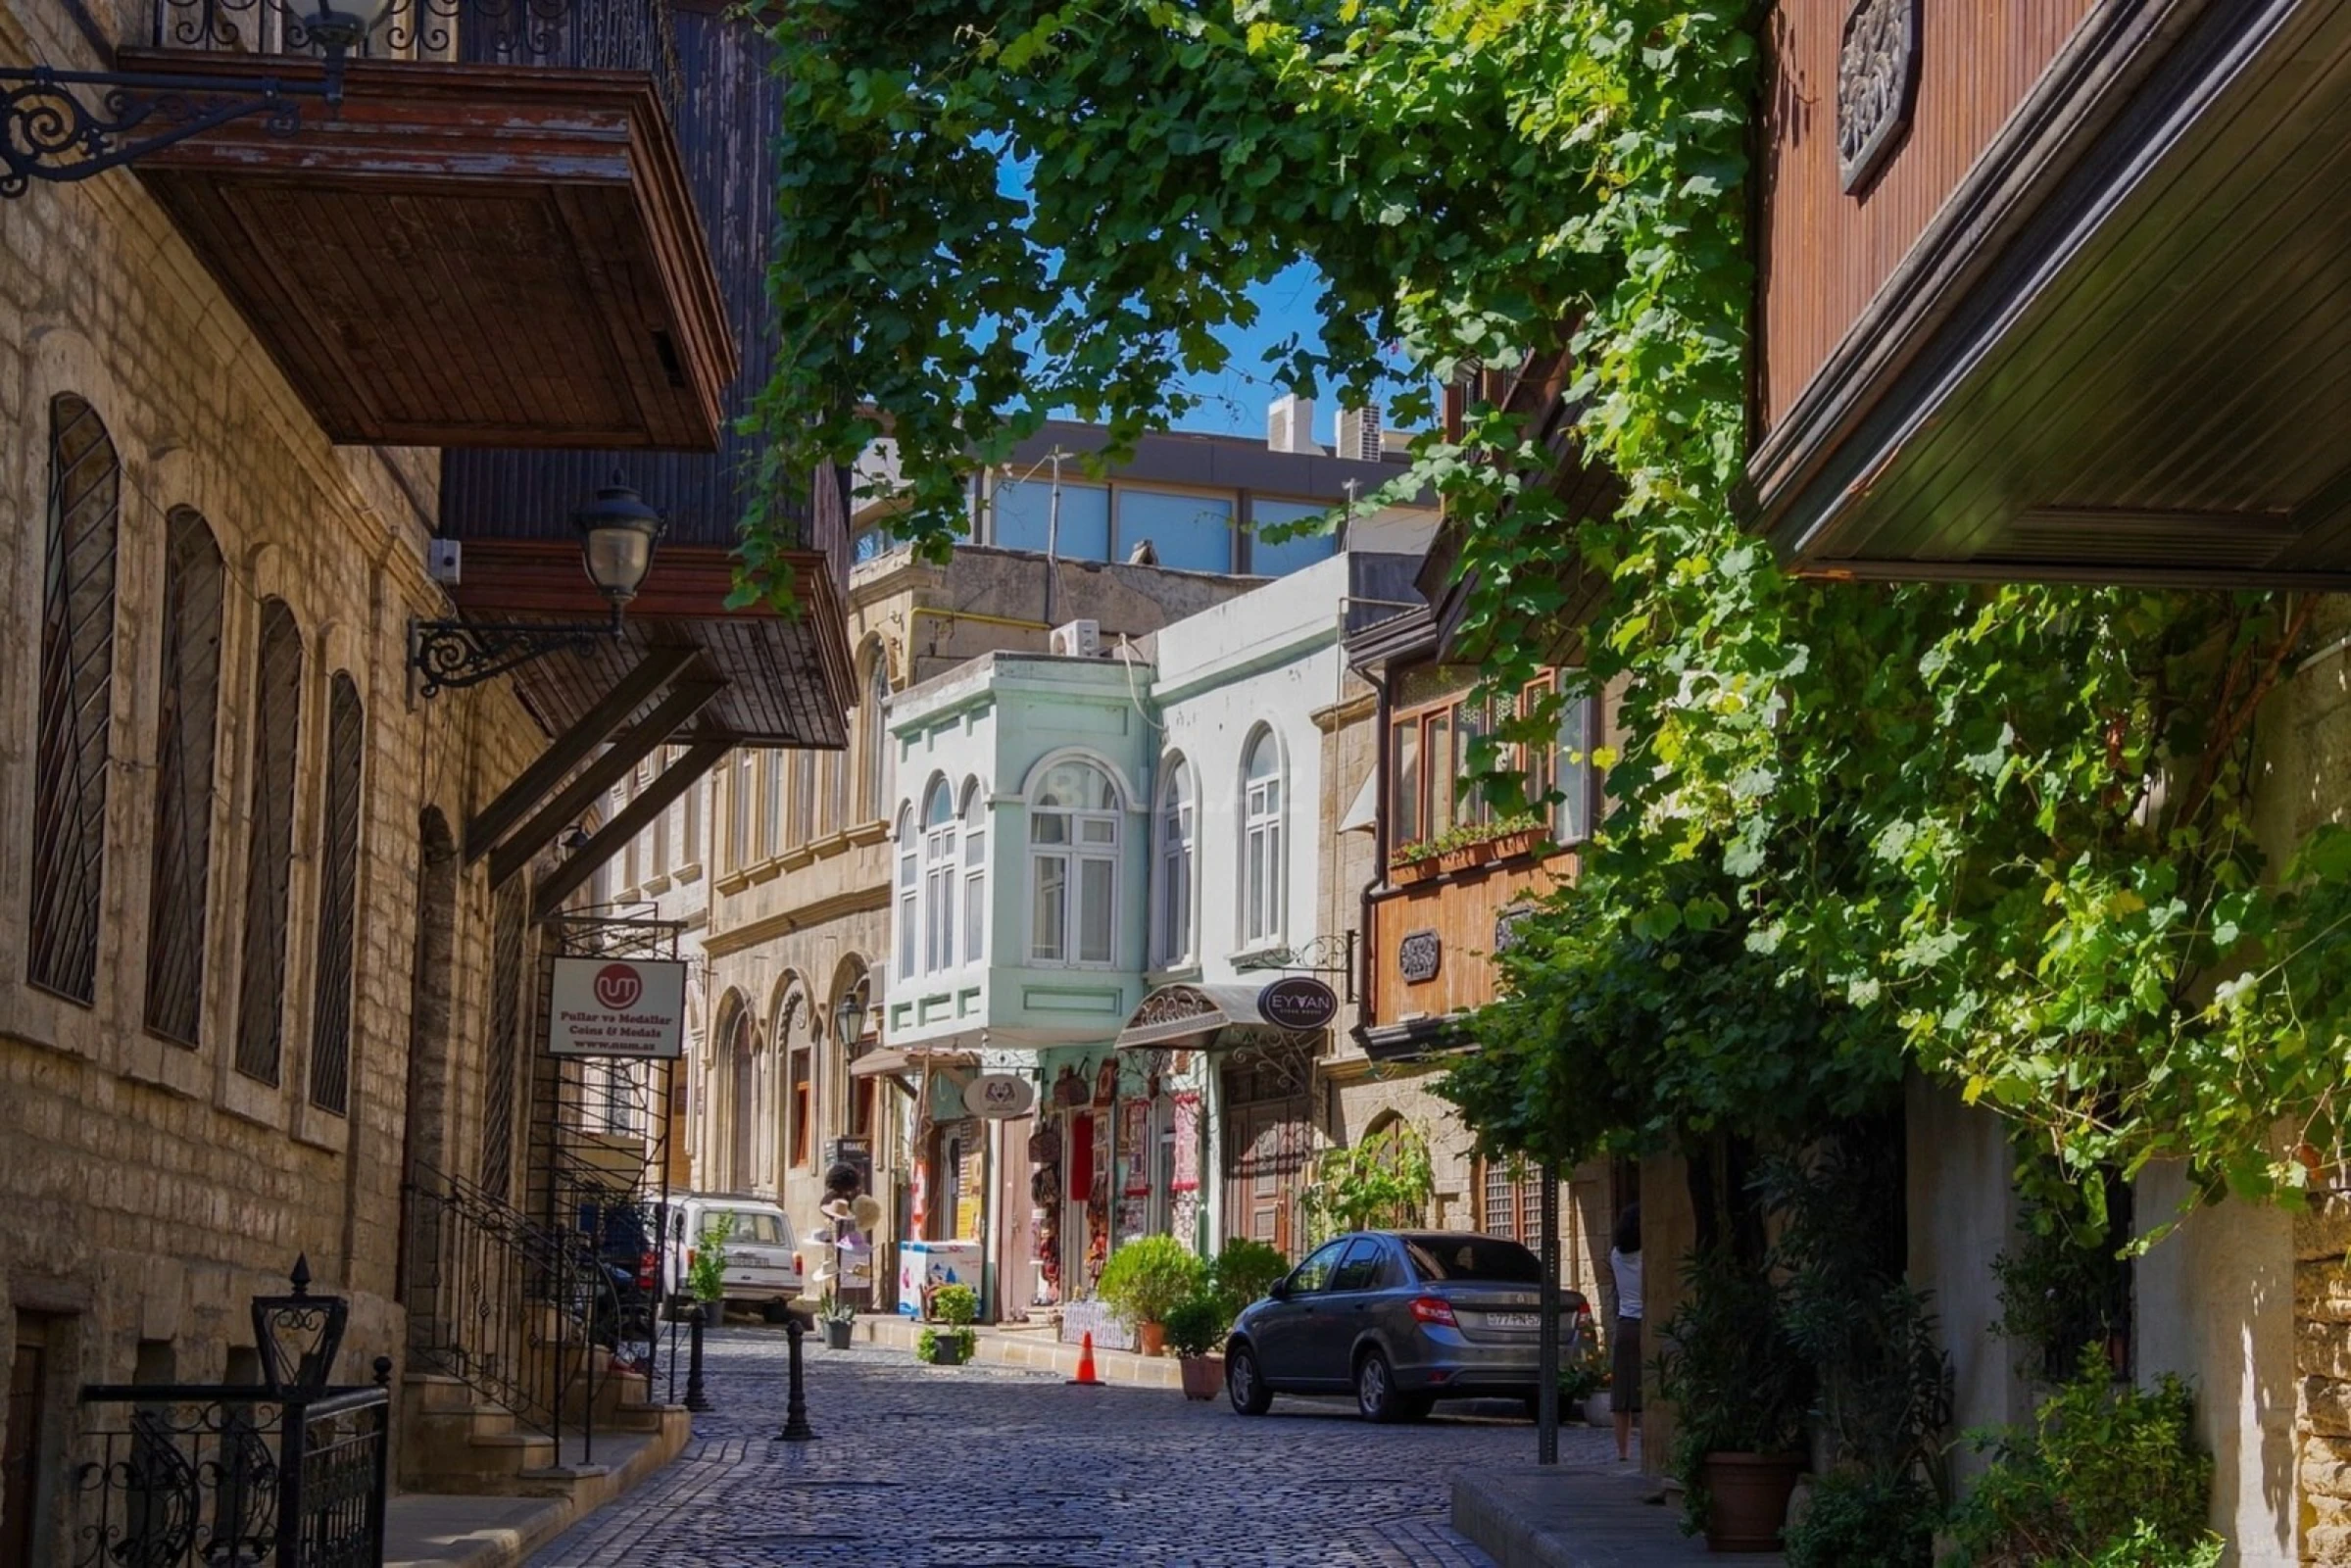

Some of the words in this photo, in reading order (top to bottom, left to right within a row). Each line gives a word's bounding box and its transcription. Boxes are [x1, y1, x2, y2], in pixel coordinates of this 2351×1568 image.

[561, 1011, 599, 1022] Pullar
[619, 1013, 672, 1025] Medallar
[569, 1025, 603, 1036] Coins
[620, 1027, 661, 1038] Medals
